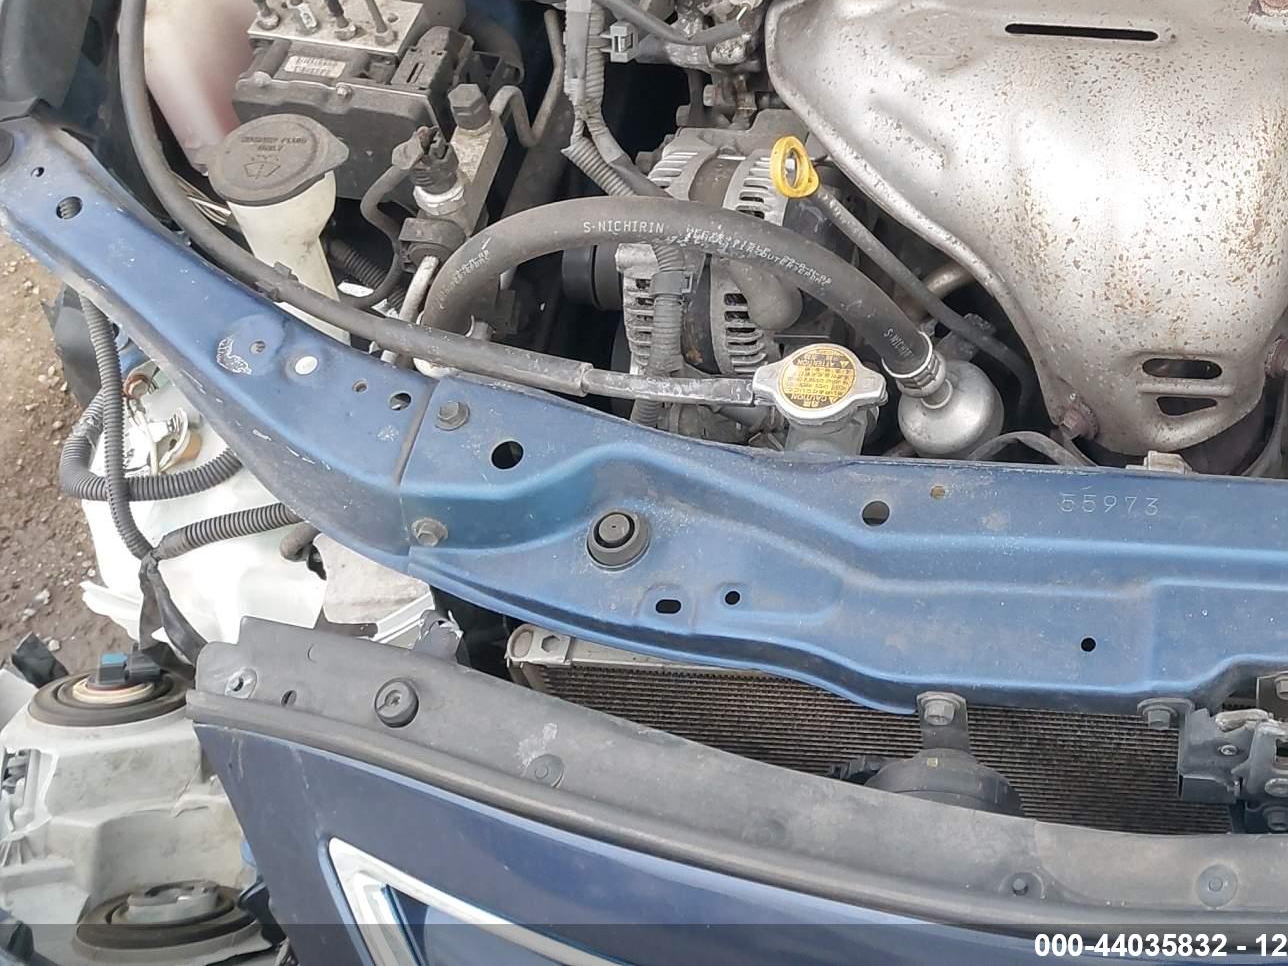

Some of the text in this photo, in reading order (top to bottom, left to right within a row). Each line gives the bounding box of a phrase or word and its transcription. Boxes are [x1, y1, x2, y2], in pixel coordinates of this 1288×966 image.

[583, 220, 665, 234] S-NICHIRIN
[790, 394, 827, 402] CAUTION
[1059, 493, 1160, 516] 55973
